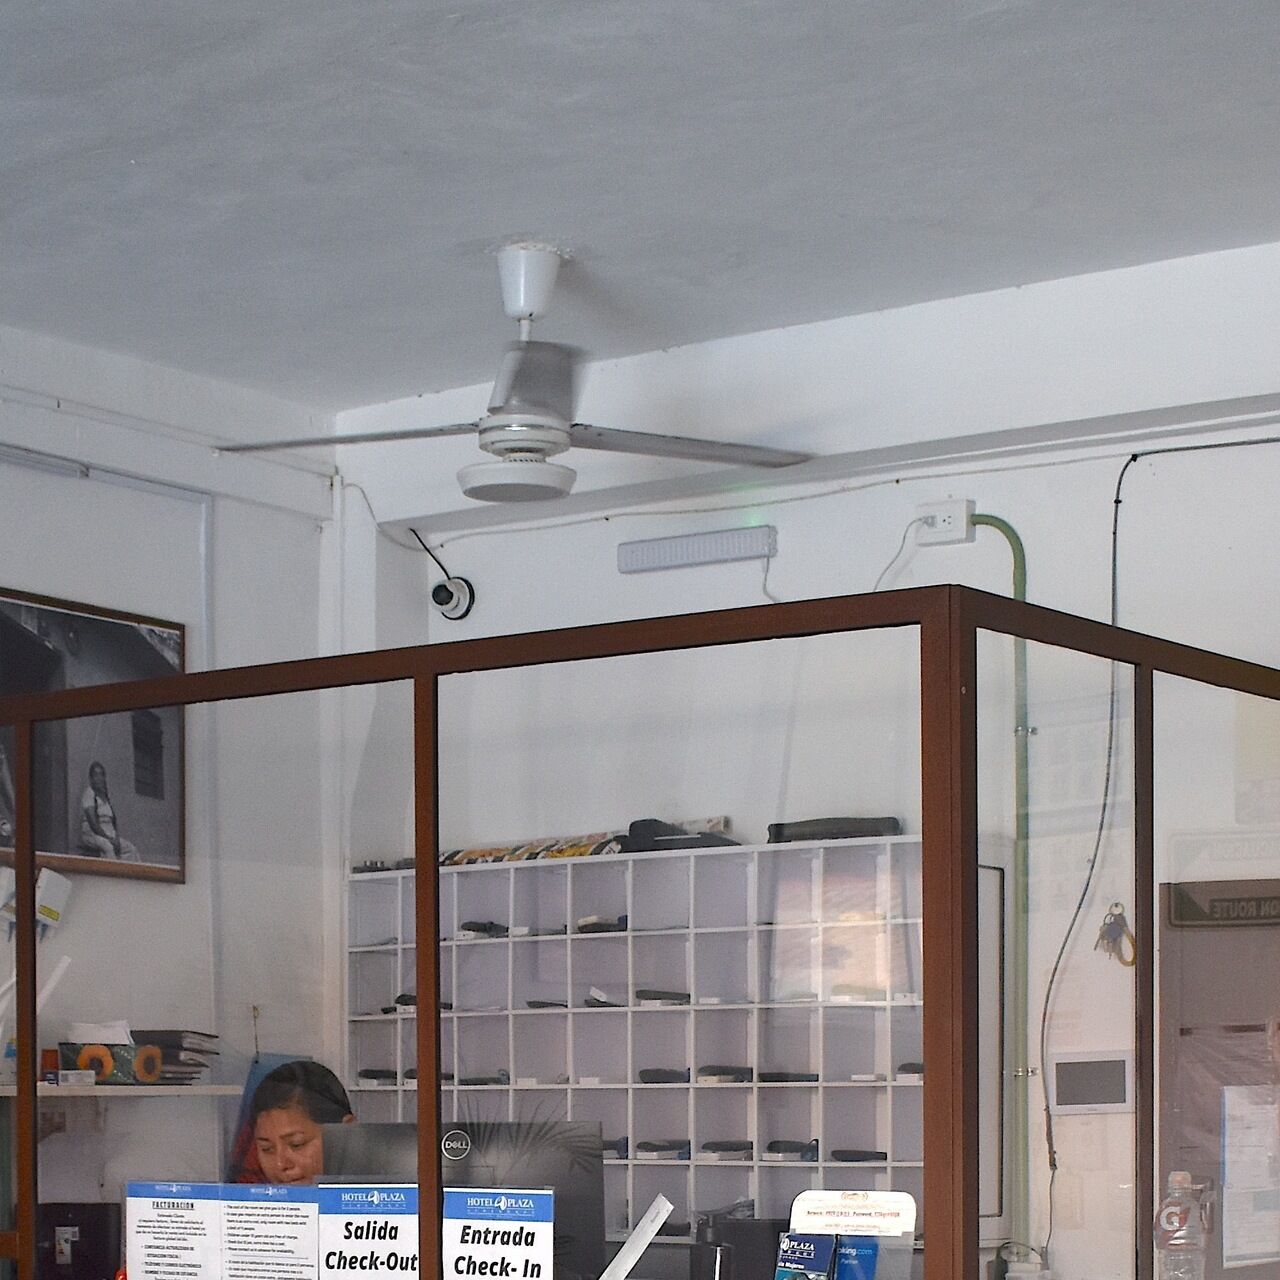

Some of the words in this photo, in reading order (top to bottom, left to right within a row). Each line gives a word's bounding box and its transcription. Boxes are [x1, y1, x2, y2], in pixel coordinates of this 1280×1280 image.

[446, 1141, 468, 1149] DELL
[342, 1193, 368, 1201] HOTEL
[380, 1193, 405, 1201] PLAZA
[467, 1197, 495, 1207] HOTEL
[508, 1198, 534, 1208] PLAZA
[344, 1220, 398, 1240] Salida
[460, 1225, 535, 1246] Entrada
[790, 1241, 814, 1251] PLAZA
[325, 1250, 418, 1271] Check-Out
[454, 1256, 517, 1276] Check-
[523, 1259, 541, 1278] In
